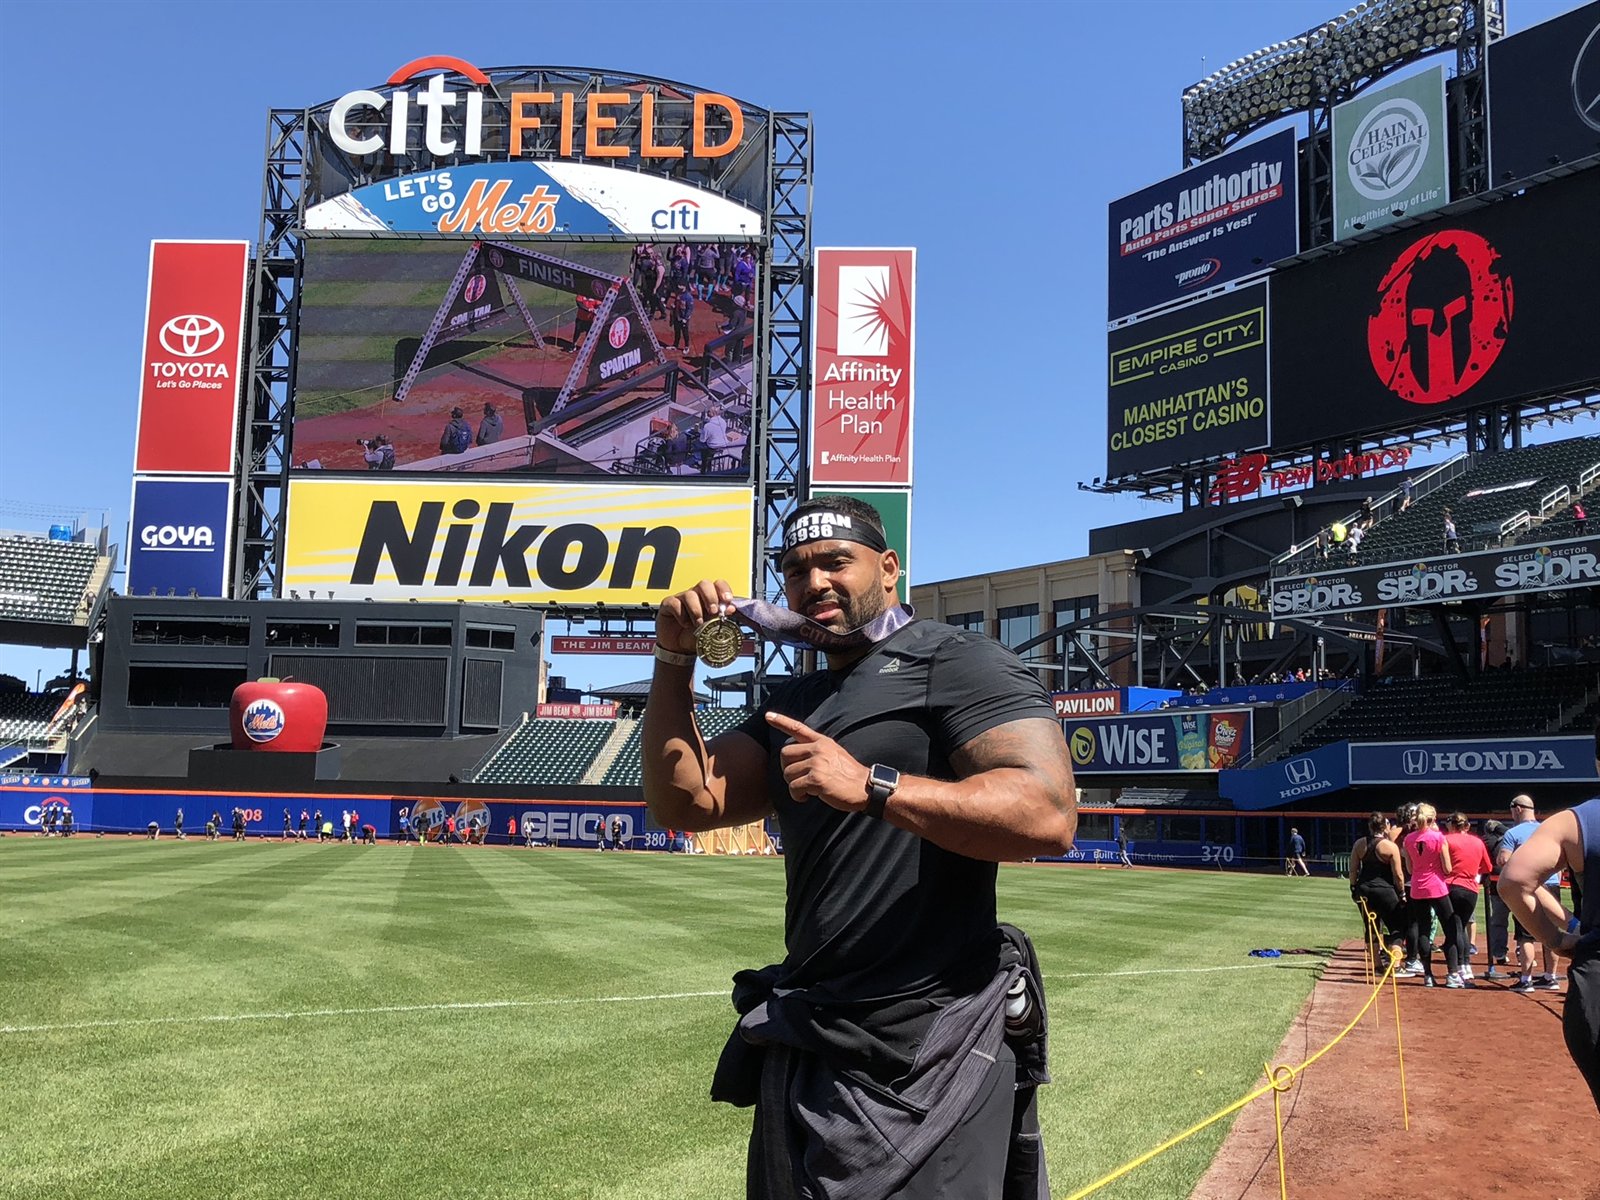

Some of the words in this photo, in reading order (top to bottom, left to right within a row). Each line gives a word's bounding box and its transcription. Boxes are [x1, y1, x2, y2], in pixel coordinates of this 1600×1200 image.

[329, 73, 482, 156] citi
[510, 92, 744, 157] FIELD
[1368, 120, 1407, 145] HAIN
[1350, 125, 1427, 165] CELESTIAL
[384, 173, 452, 201] LET'S
[422, 192, 455, 213] GO
[437, 179, 560, 233] Mets
[1120, 202, 1173, 244] Parts
[1177, 161, 1282, 222] Authority
[651, 205, 698, 230] citi
[1125, 236, 1152, 253] Auto
[1155, 223, 1188, 241] Parts
[1190, 206, 1229, 227] Super
[1232, 189, 1277, 211] Stores
[1344, 219, 1349, 230] A
[1168, 231, 1211, 254] Answer
[1213, 226, 1224, 238] Is
[519, 258, 574, 288] FINISH
[1118, 338, 1197, 373] EMPIRE
[1203, 321, 1252, 347] CITY
[151, 362, 229, 378] TOYOTA
[600, 348, 641, 379] SPARTAN
[824, 362, 902, 387] Affinity
[1159, 353, 1209, 374] CASINO
[157, 380, 177, 388] Let's
[179, 380, 191, 388] Go
[192, 380, 222, 389] Places
[829, 390, 895, 410] Health
[1124, 377, 1248, 426] MANHATTAN'S
[841, 414, 882, 434] Plan
[1110, 416, 1188, 451] CLOSEST
[1193, 397, 1264, 431] CASINO
[830, 454, 858, 463] Affinity
[859, 454, 883, 462] Health
[885, 454, 901, 463] Plan
[1271, 467, 1314, 490] new
[1317, 448, 1411, 481] balance
[141, 525, 212, 547] GOYA
[350, 499, 682, 590] Nikon
[1503, 554, 1534, 563] SELECT
[1553, 547, 1587, 556] SECTOR
[1384, 569, 1412, 578] SELECT
[1427, 563, 1458, 572] SECTOR
[1280, 583, 1305, 591] SELECT
[1319, 577, 1345, 586] SECTOR
[561, 641, 586, 649] THE
[590, 641, 610, 649] JIM
[616, 641, 650, 650] BEAM
[540, 705, 552, 715] JIM
[553, 706, 570, 716] BEAM
[582, 706, 594, 716] JIM
[595, 706, 613, 716] BEAM
[1055, 696, 1115, 714] PAVILION
[249, 714, 277, 729] Mets
[1098, 724, 1166, 765] WISE
[1432, 750, 1565, 772] HONDA
[1279, 779, 1332, 799] HONDA
[521, 811, 634, 842] GEICO
[644, 832, 666, 847] 380
[1094, 850, 1114, 859] Built
[1201, 845, 1234, 862] 370
